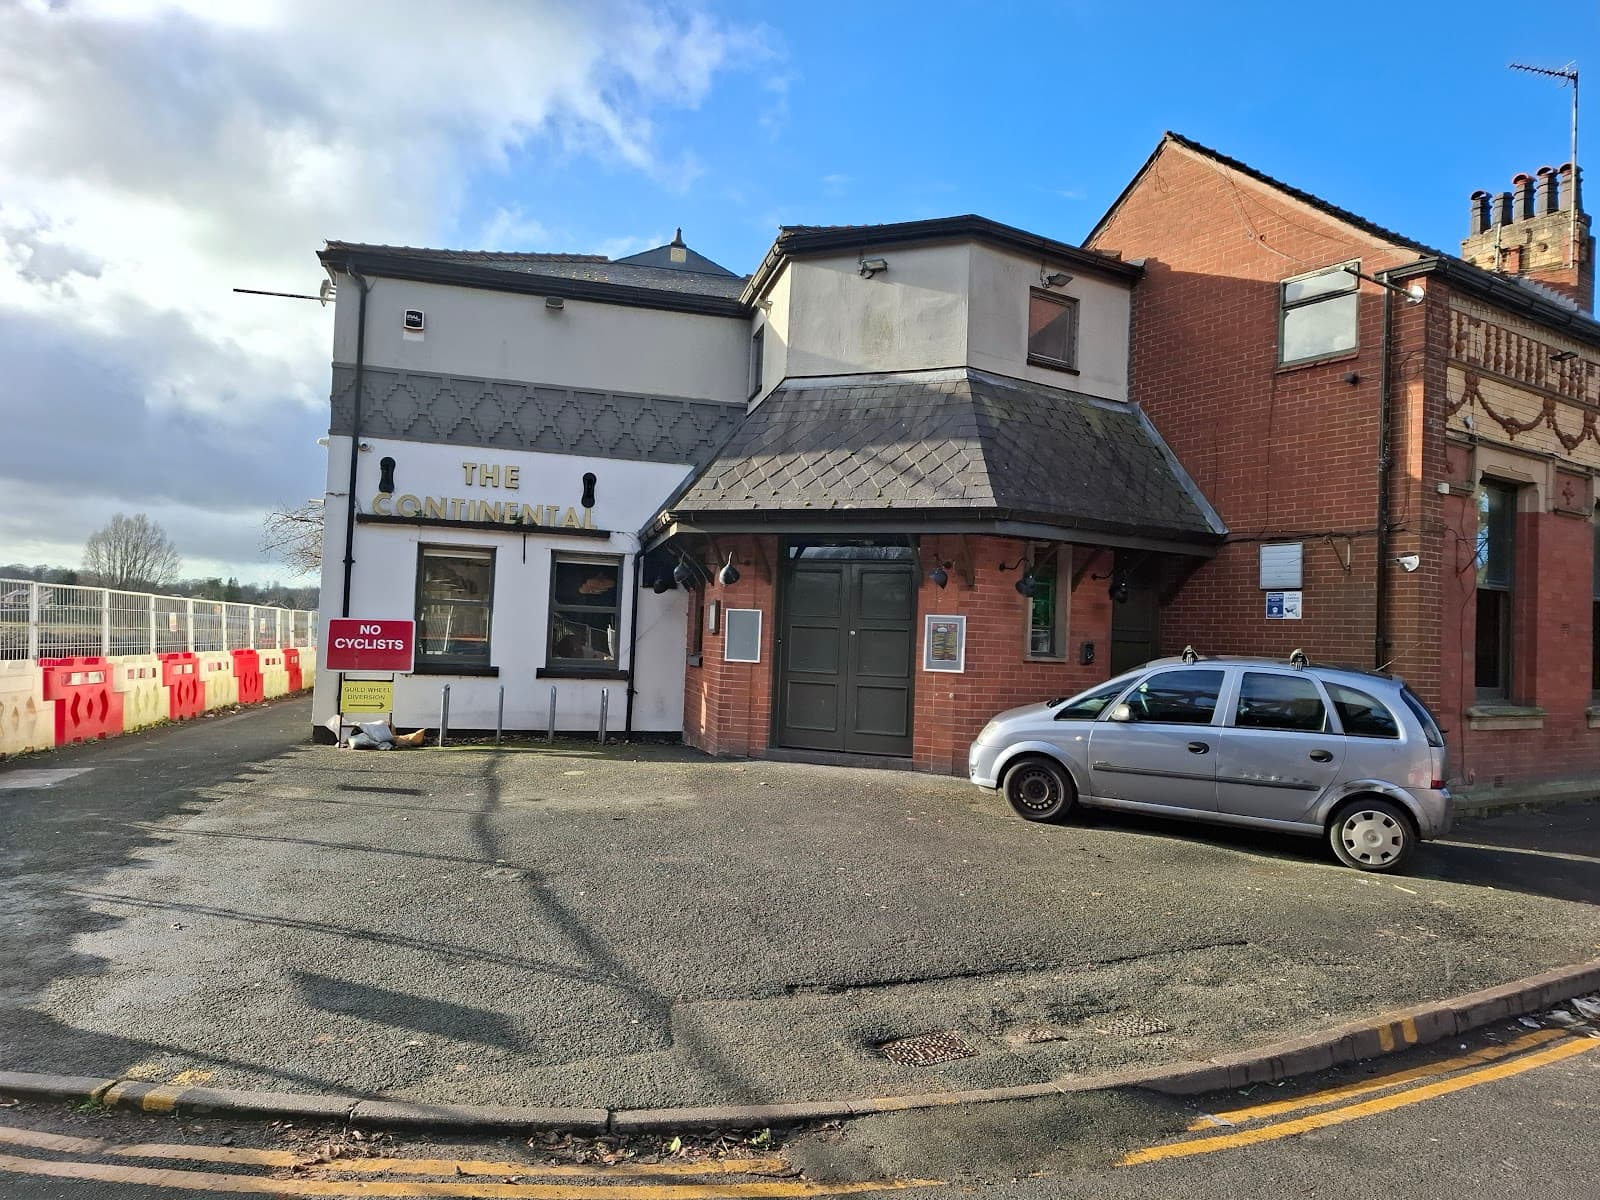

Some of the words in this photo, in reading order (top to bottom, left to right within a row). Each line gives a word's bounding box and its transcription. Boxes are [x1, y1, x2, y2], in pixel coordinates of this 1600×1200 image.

[462, 462, 520, 489] THE
[372, 492, 598, 530] CONTINENTAL
[359, 624, 381, 635] NO
[334, 638, 404, 650] CYCLISTS
